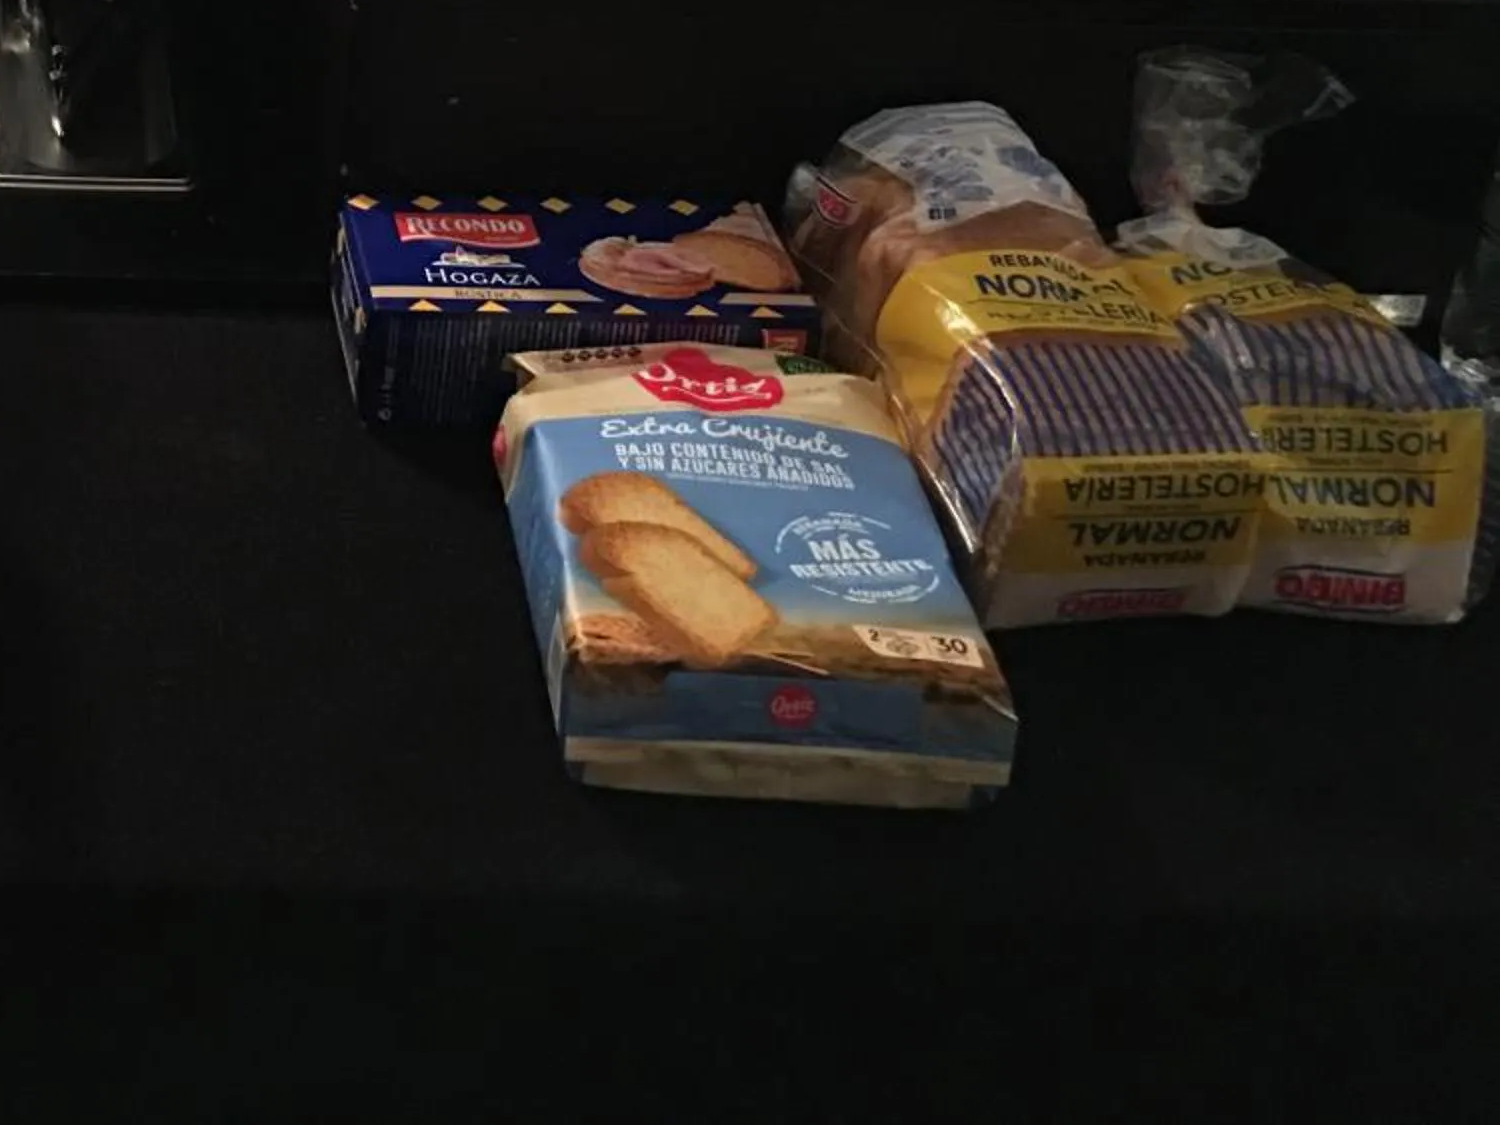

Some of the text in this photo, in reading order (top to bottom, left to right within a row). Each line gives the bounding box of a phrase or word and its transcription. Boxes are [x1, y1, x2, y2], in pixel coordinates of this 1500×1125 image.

[405, 217, 526, 236] RECONDO
[424, 267, 541, 287] HOGAZA
[600, 417, 849, 458] Extra Crujiente
[614, 442, 844, 476] BAJO CONTENIDO DE SAL
[618, 456, 630, 470] Y
[636, 457, 666, 471] SIN
[1270, 474, 1436, 508] NORMAL
[1068, 516, 1242, 547] NORMAL
[808, 532, 881, 561] MÁS
[790, 558, 934, 580] RESISTENTE
[868, 628, 968, 655] 2 30
